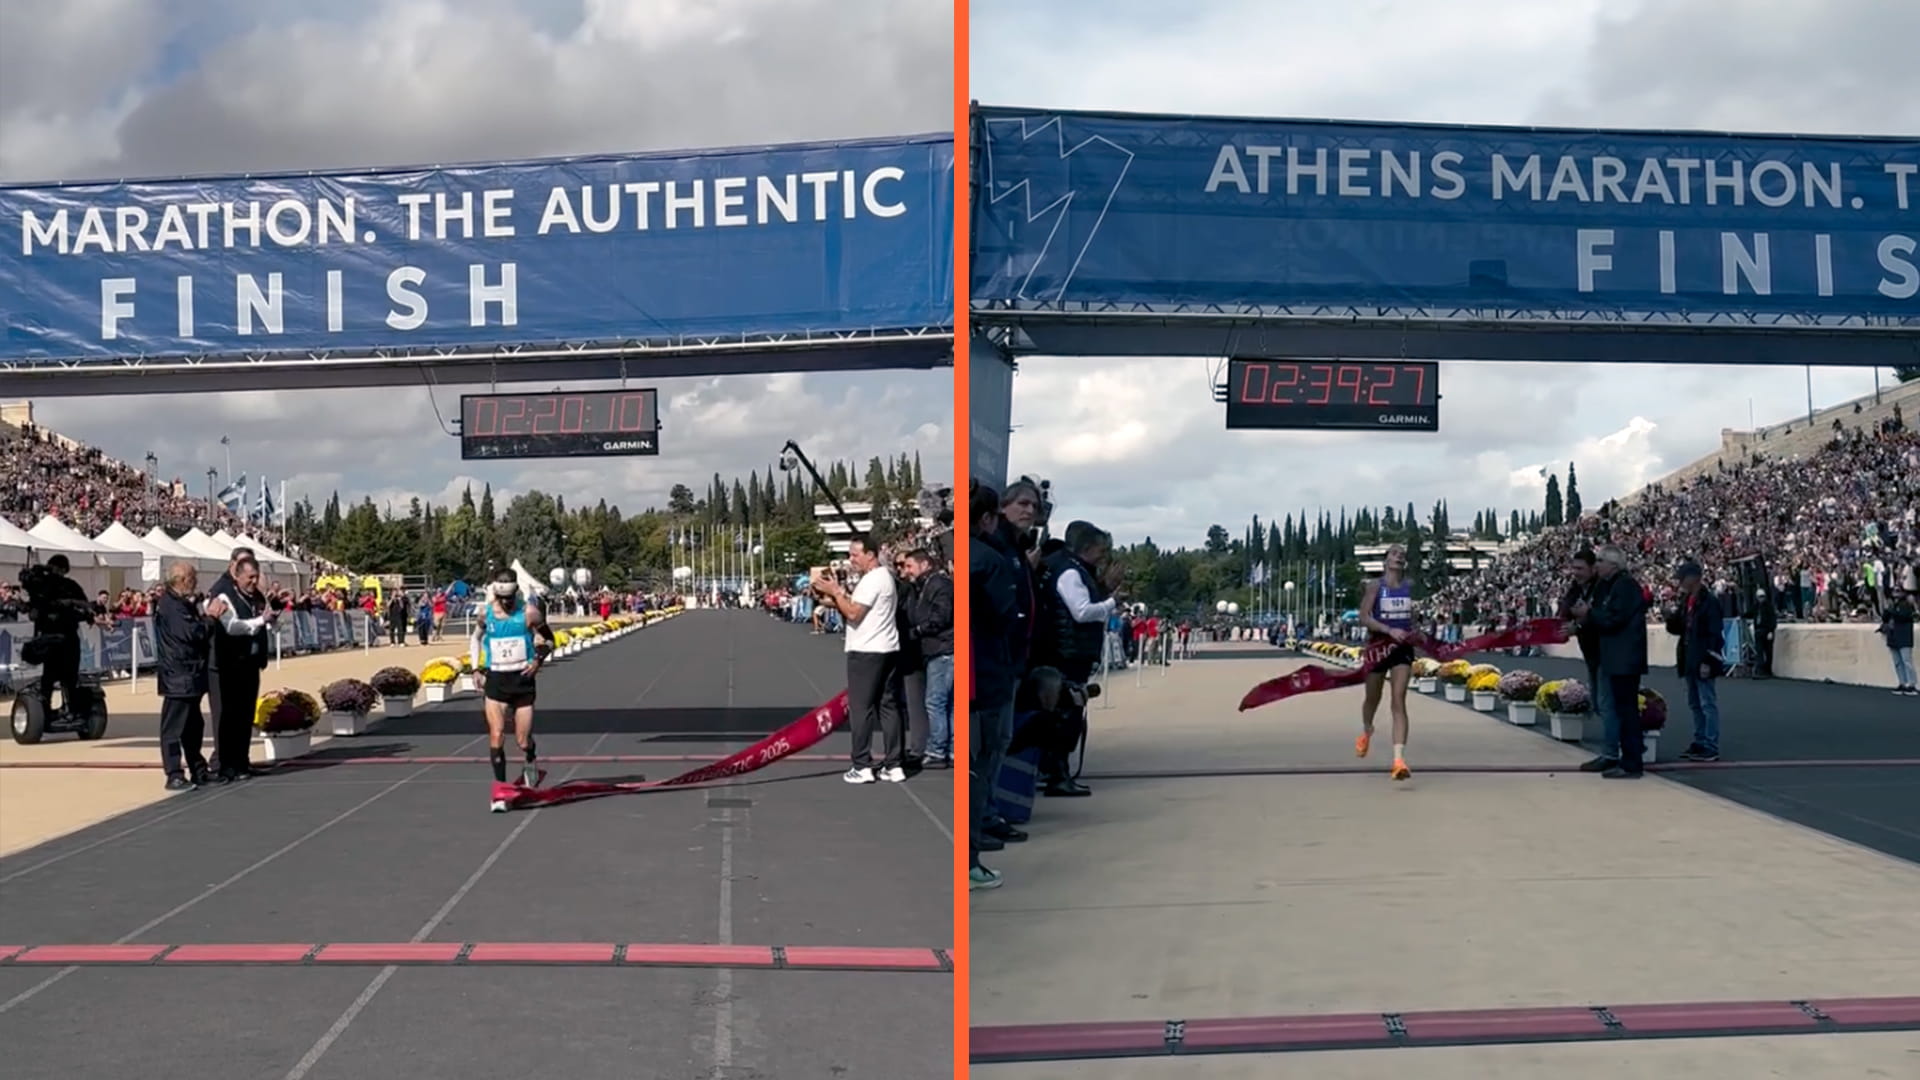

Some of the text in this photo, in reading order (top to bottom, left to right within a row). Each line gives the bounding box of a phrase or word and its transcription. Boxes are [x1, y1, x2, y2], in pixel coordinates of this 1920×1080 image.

[1204, 144, 1466, 200] ATHENS
[1492, 153, 1864, 210] MARATHON.
[22, 166, 908, 255] MARATHON. THE AUTHENTIC
[1577, 229, 1920, 300] FINIS
[100, 262, 518, 340] FINISH
[1241, 364, 1425, 405] 02:39:27
[474, 394, 644, 436] 02:20:10
[502, 649, 513, 658] 21
[760, 737, 790, 763] 2025
